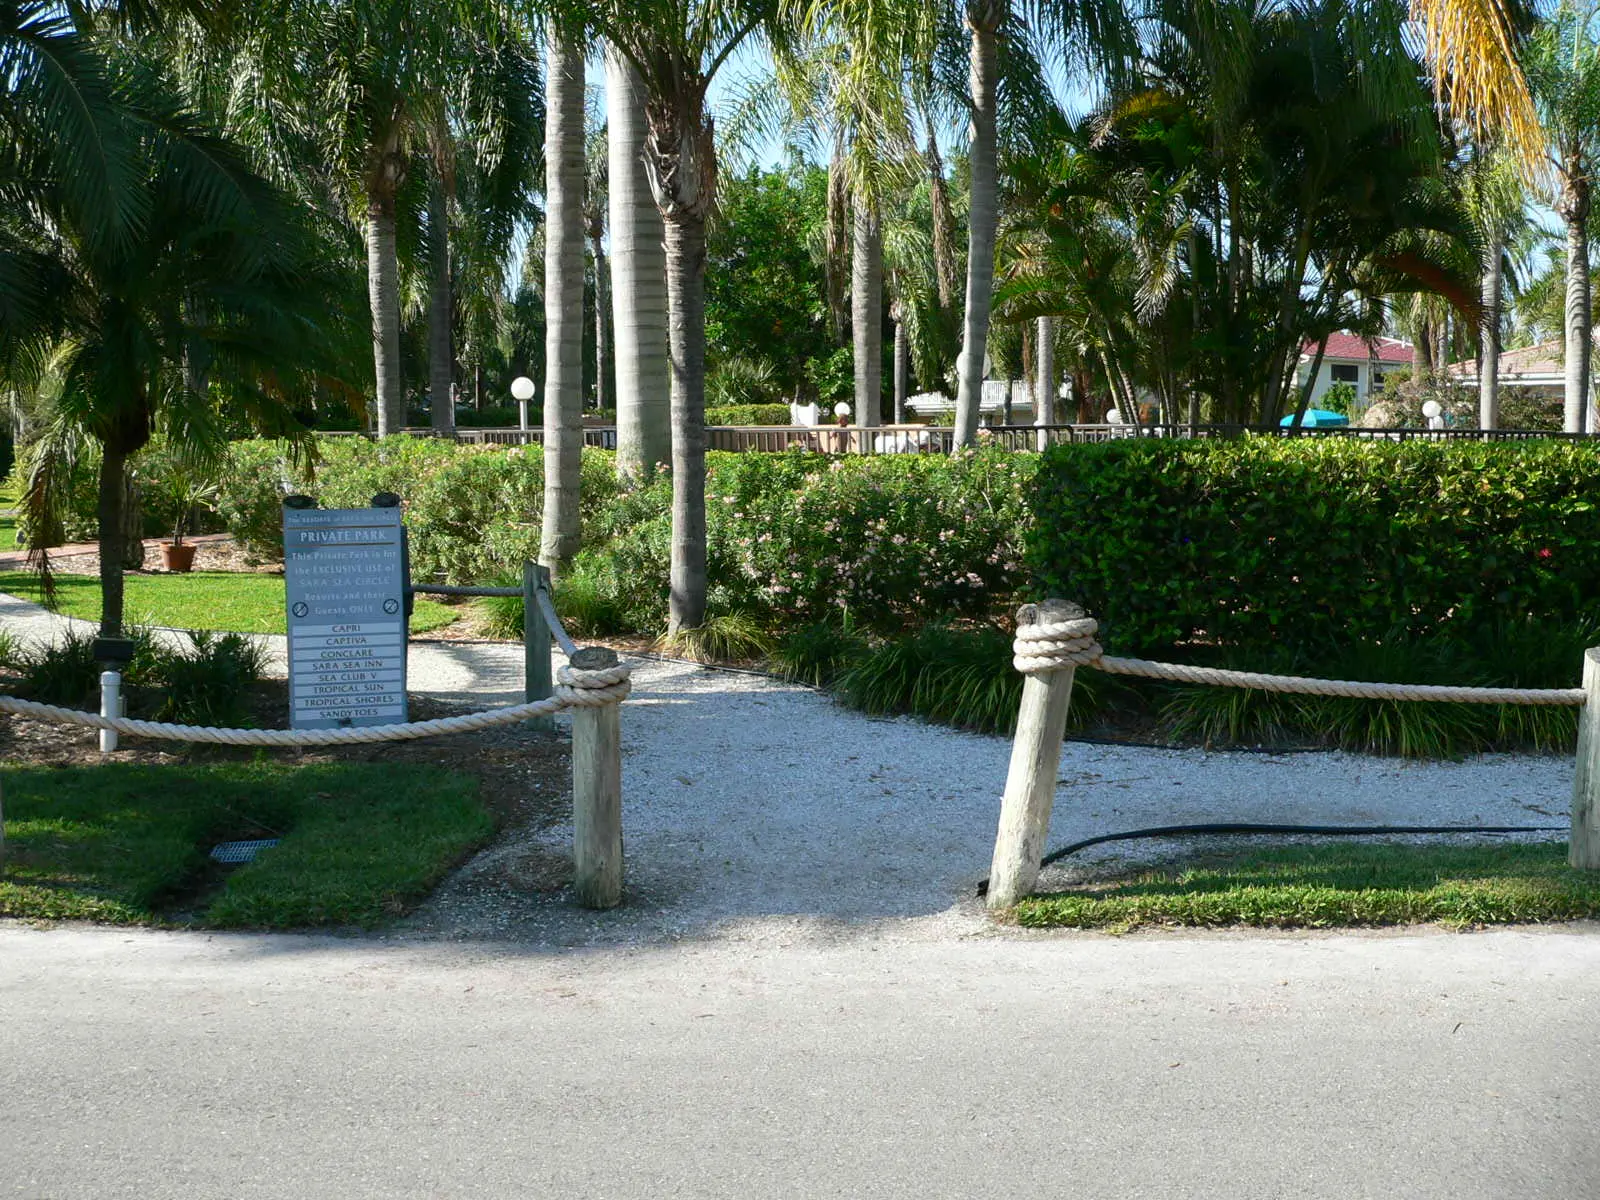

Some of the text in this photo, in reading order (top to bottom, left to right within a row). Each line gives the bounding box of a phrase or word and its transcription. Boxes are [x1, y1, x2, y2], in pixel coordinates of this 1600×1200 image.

[300, 530, 386, 542] PRIVATE PARK
[295, 566, 310, 575] the
[312, 564, 362, 574] EXCLUSIVE
[356, 576, 390, 586] CIRCLE
[332, 624, 361, 633] CAPRI
[326, 636, 367, 646] CAPTIVA
[320, 649, 374, 658] CONCLARE
[312, 660, 384, 670] SARA SEA INN
[319, 672, 378, 682] SEA CLUB V
[313, 684, 384, 694] TROPICAL SUN
[304, 696, 394, 707] TROPICAL SHORES
